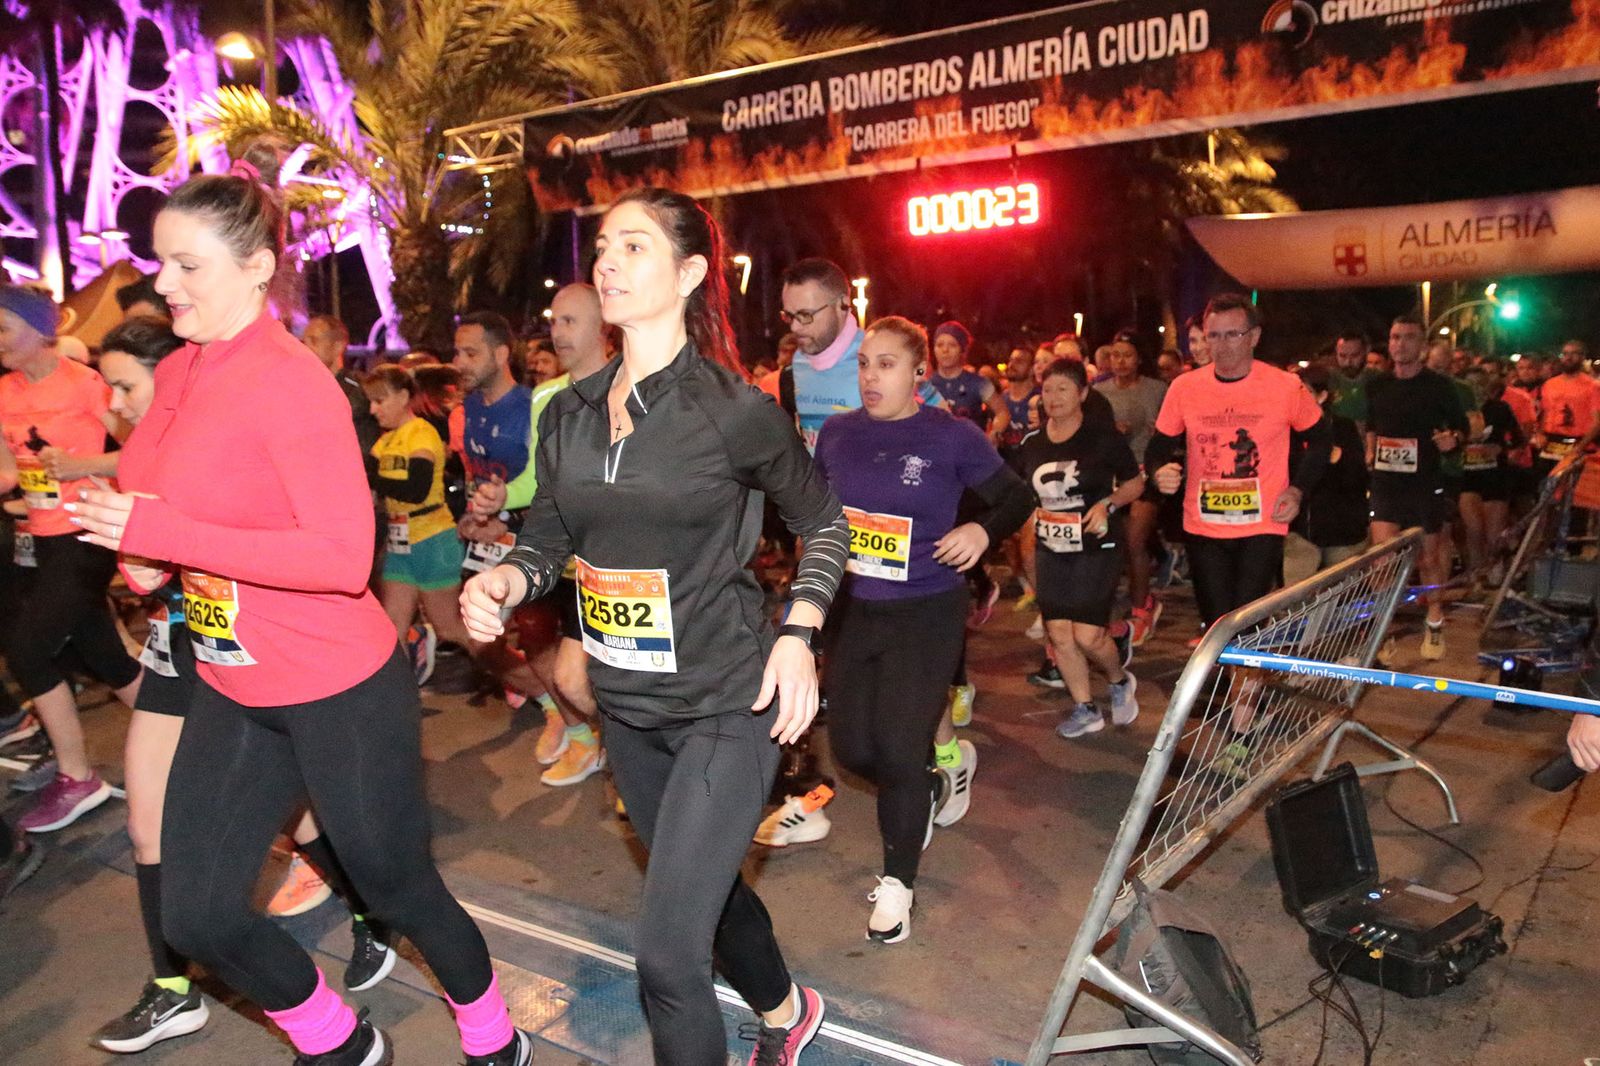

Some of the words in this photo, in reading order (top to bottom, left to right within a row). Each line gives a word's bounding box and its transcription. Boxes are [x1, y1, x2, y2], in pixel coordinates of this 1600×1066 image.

[722, 80, 826, 132] CARRERA
[829, 56, 964, 113] BOMBEROS
[968, 26, 1091, 90] ALMERÍA
[1098, 9, 1209, 68] CIUDAD
[934, 110, 970, 140] DEL
[1399, 250, 1478, 270] CIUDAD
[1211, 494, 1252, 506] 2603
[849, 529, 897, 553] 2506
[1043, 523, 1073, 539] 128
[184, 598, 229, 629] 2626
[587, 595, 654, 628] 2582
[602, 633, 638, 650] MARIANA
